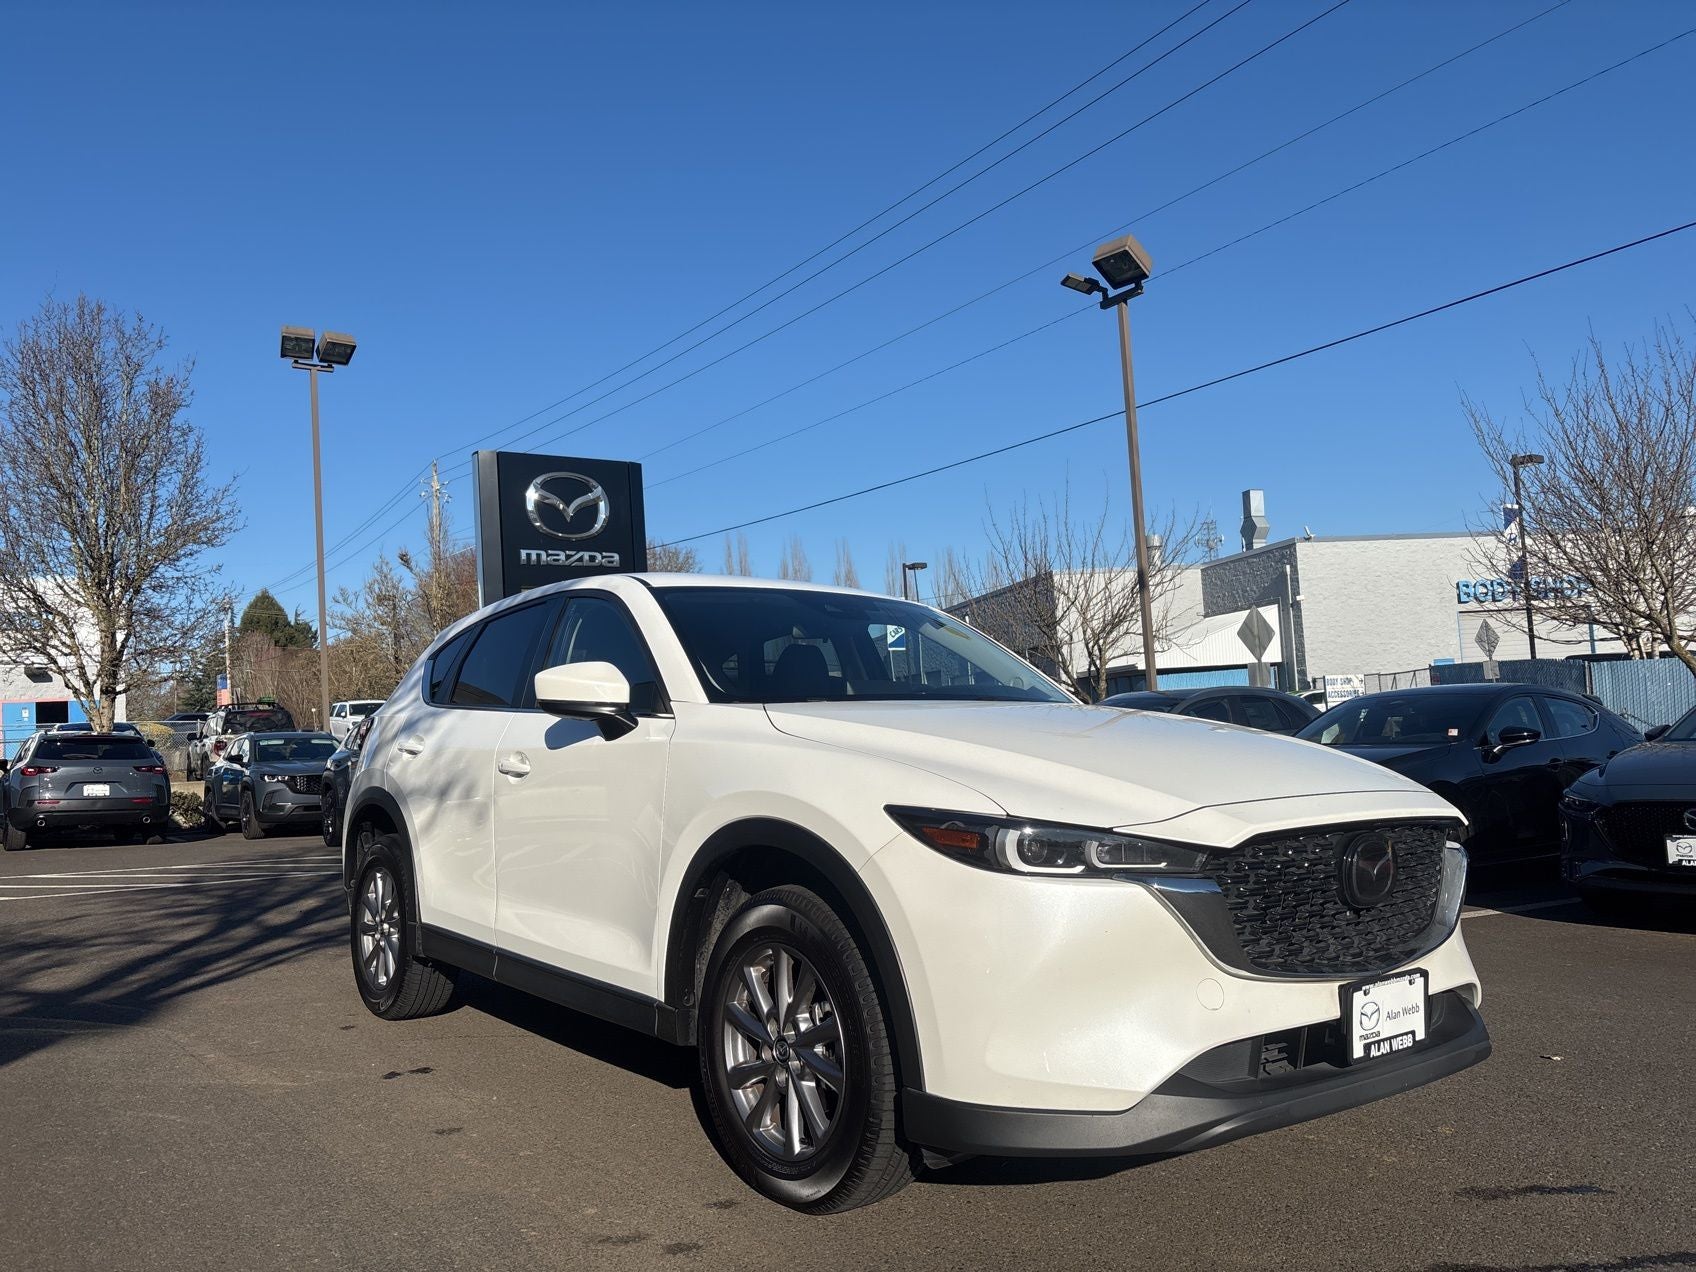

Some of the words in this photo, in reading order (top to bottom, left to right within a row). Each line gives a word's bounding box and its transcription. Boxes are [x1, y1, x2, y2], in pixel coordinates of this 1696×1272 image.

[1385, 1009, 1401, 1022] Alan
[1401, 1003, 1420, 1017] Webb
[1370, 1039, 1390, 1058] ALAN
[1390, 1034, 1413, 1052] WEBB
